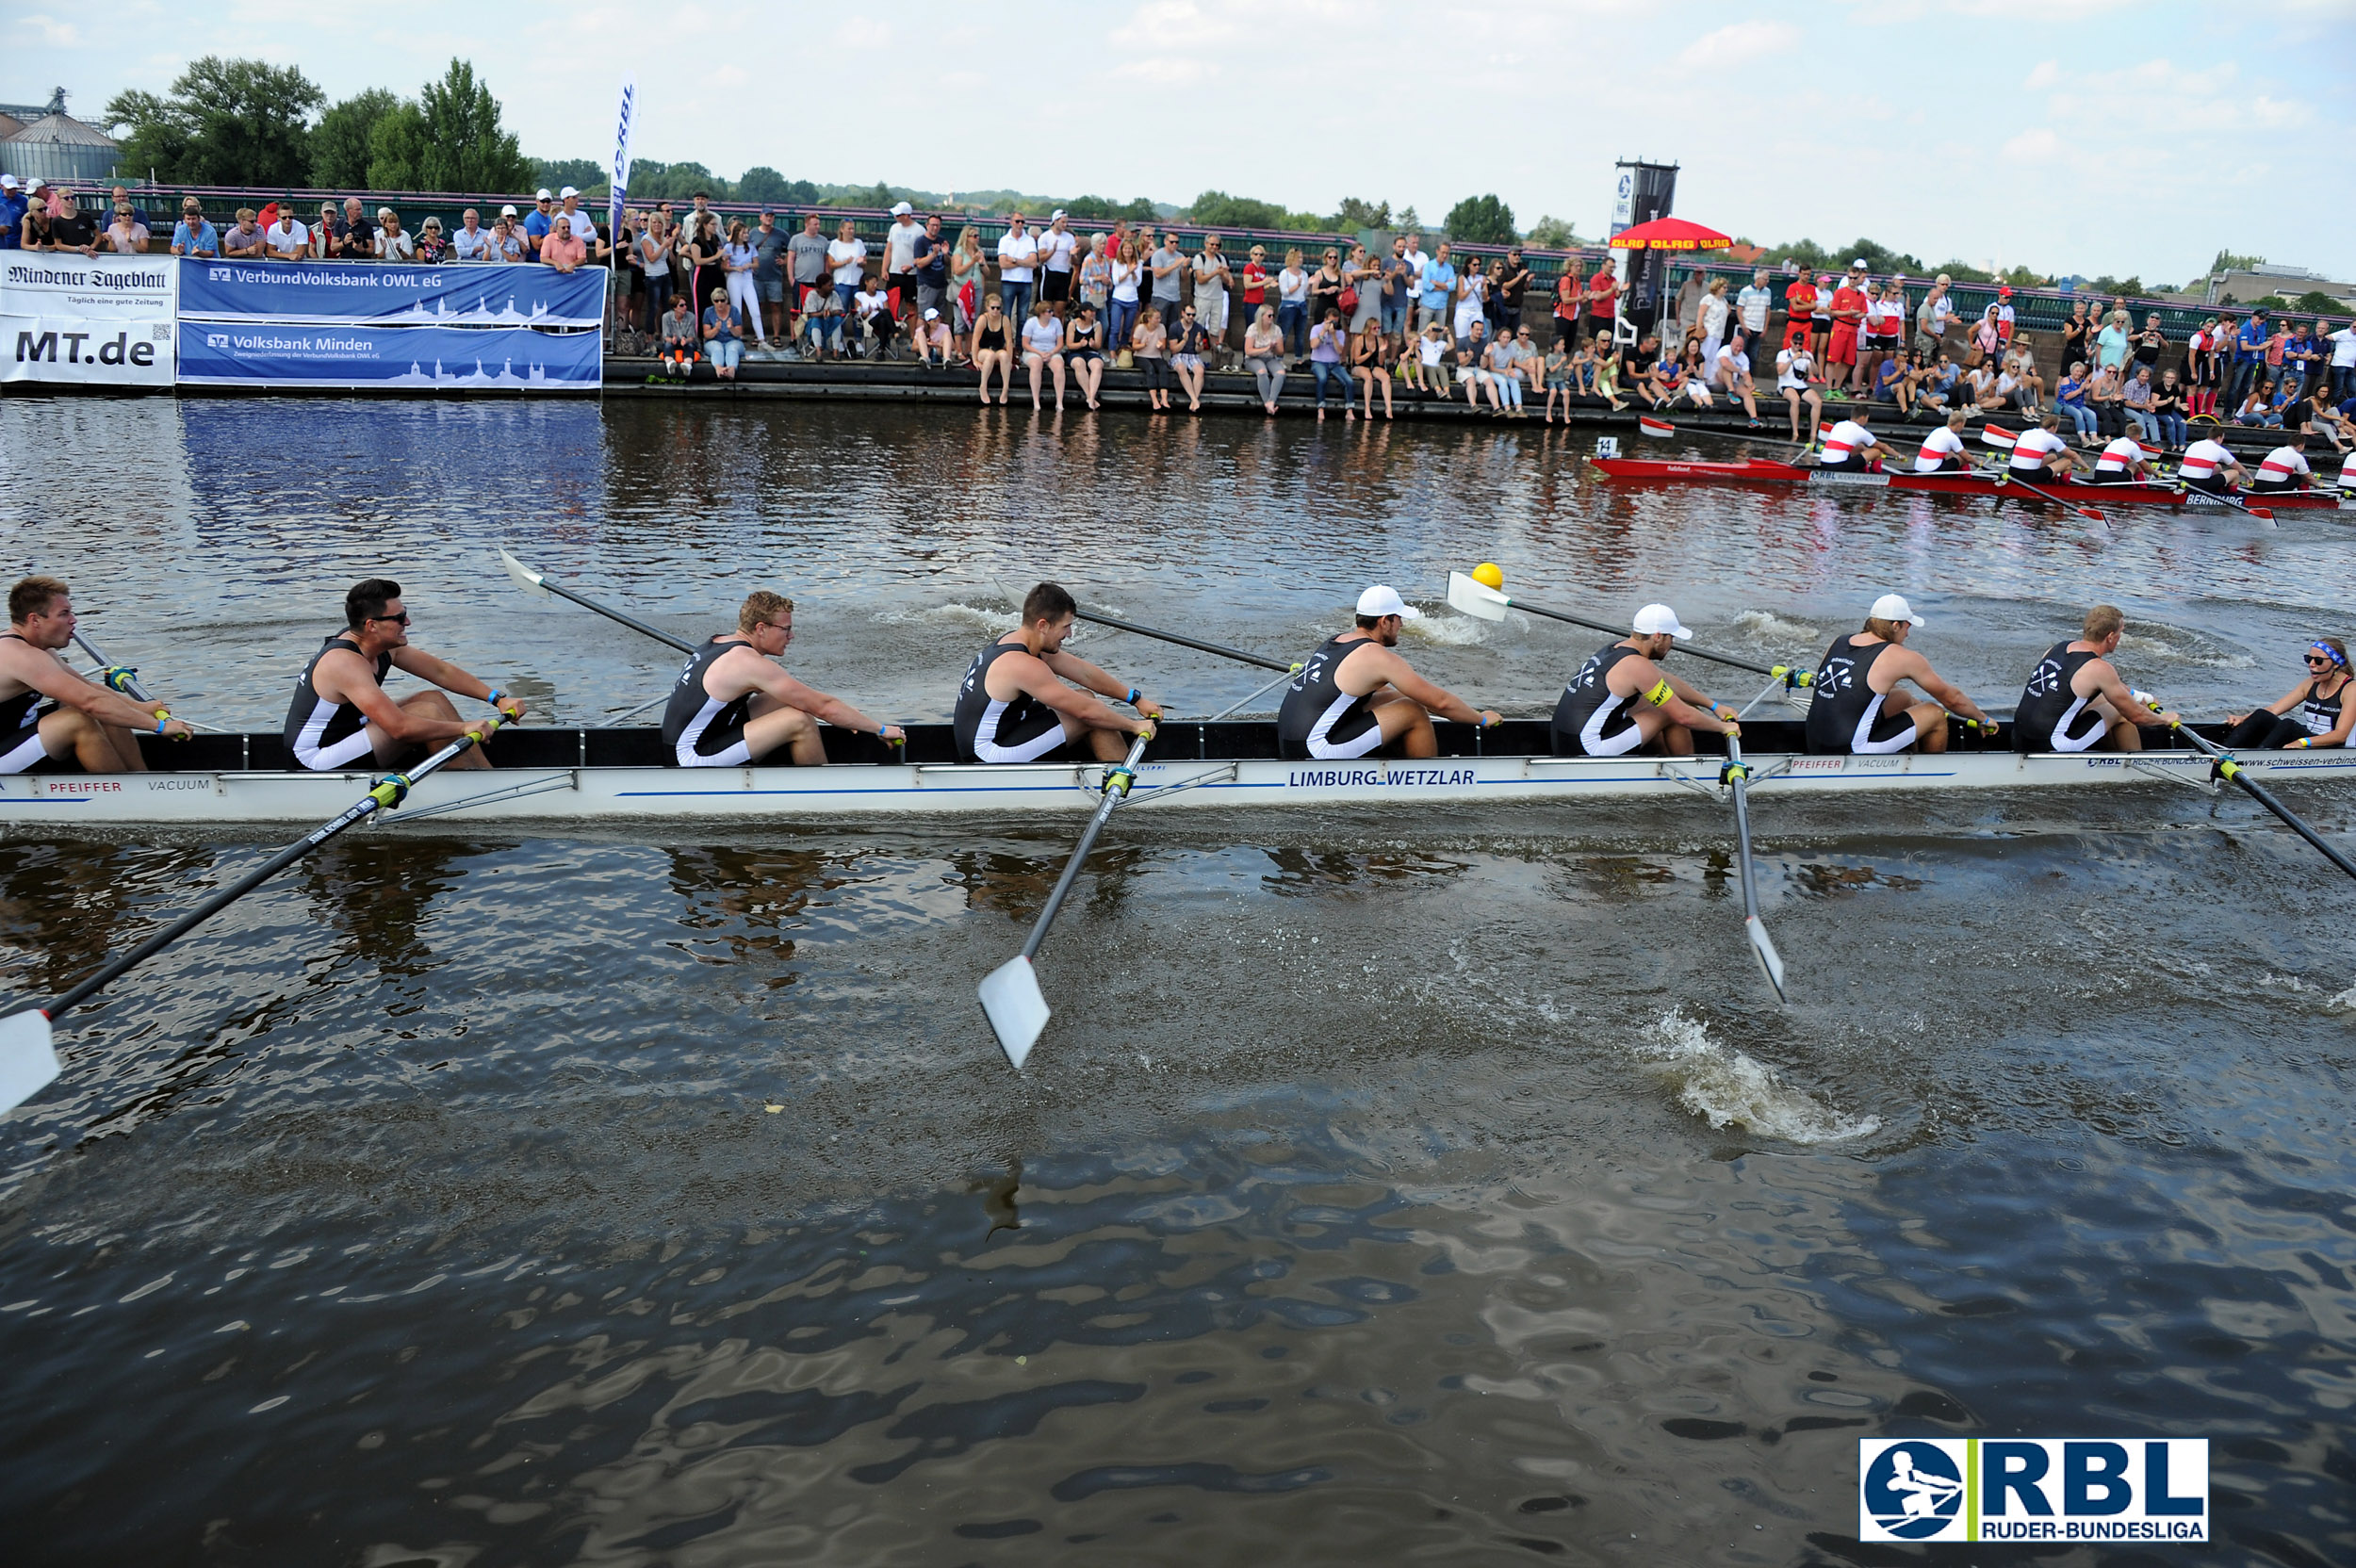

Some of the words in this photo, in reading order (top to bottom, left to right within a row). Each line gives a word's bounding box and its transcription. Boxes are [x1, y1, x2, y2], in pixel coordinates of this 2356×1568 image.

[1611, 238, 1646, 248] DLRG
[1650, 239, 1694, 249] DLRG
[8, 266, 87, 286] Mindener
[90, 270, 166, 290] Tageblatt
[236, 269, 379, 287] VerbundVolksbank
[383, 273, 418, 287] OWL
[422, 274, 442, 287] eG
[68, 296, 95, 306] Täglich
[135, 299, 164, 307] Zeitung
[16, 331, 155, 367] MT.de
[233, 335, 311, 351] Volksbank
[315, 336, 372, 351] Minden
[234, 351, 291, 359] Zweigniederlassung
[1599, 439, 1611, 452] 14
[1819, 471, 1837, 480] RBL
[1792, 760, 1841, 769] PFEIFFER
[1857, 760, 1900, 768] VACUUM
[1289, 771, 1378, 787] LIMBURG
[1386, 770, 1475, 785] WETZLAR
[50, 782, 122, 793] PFEIFFER
[147, 779, 210, 791] VACUUM
